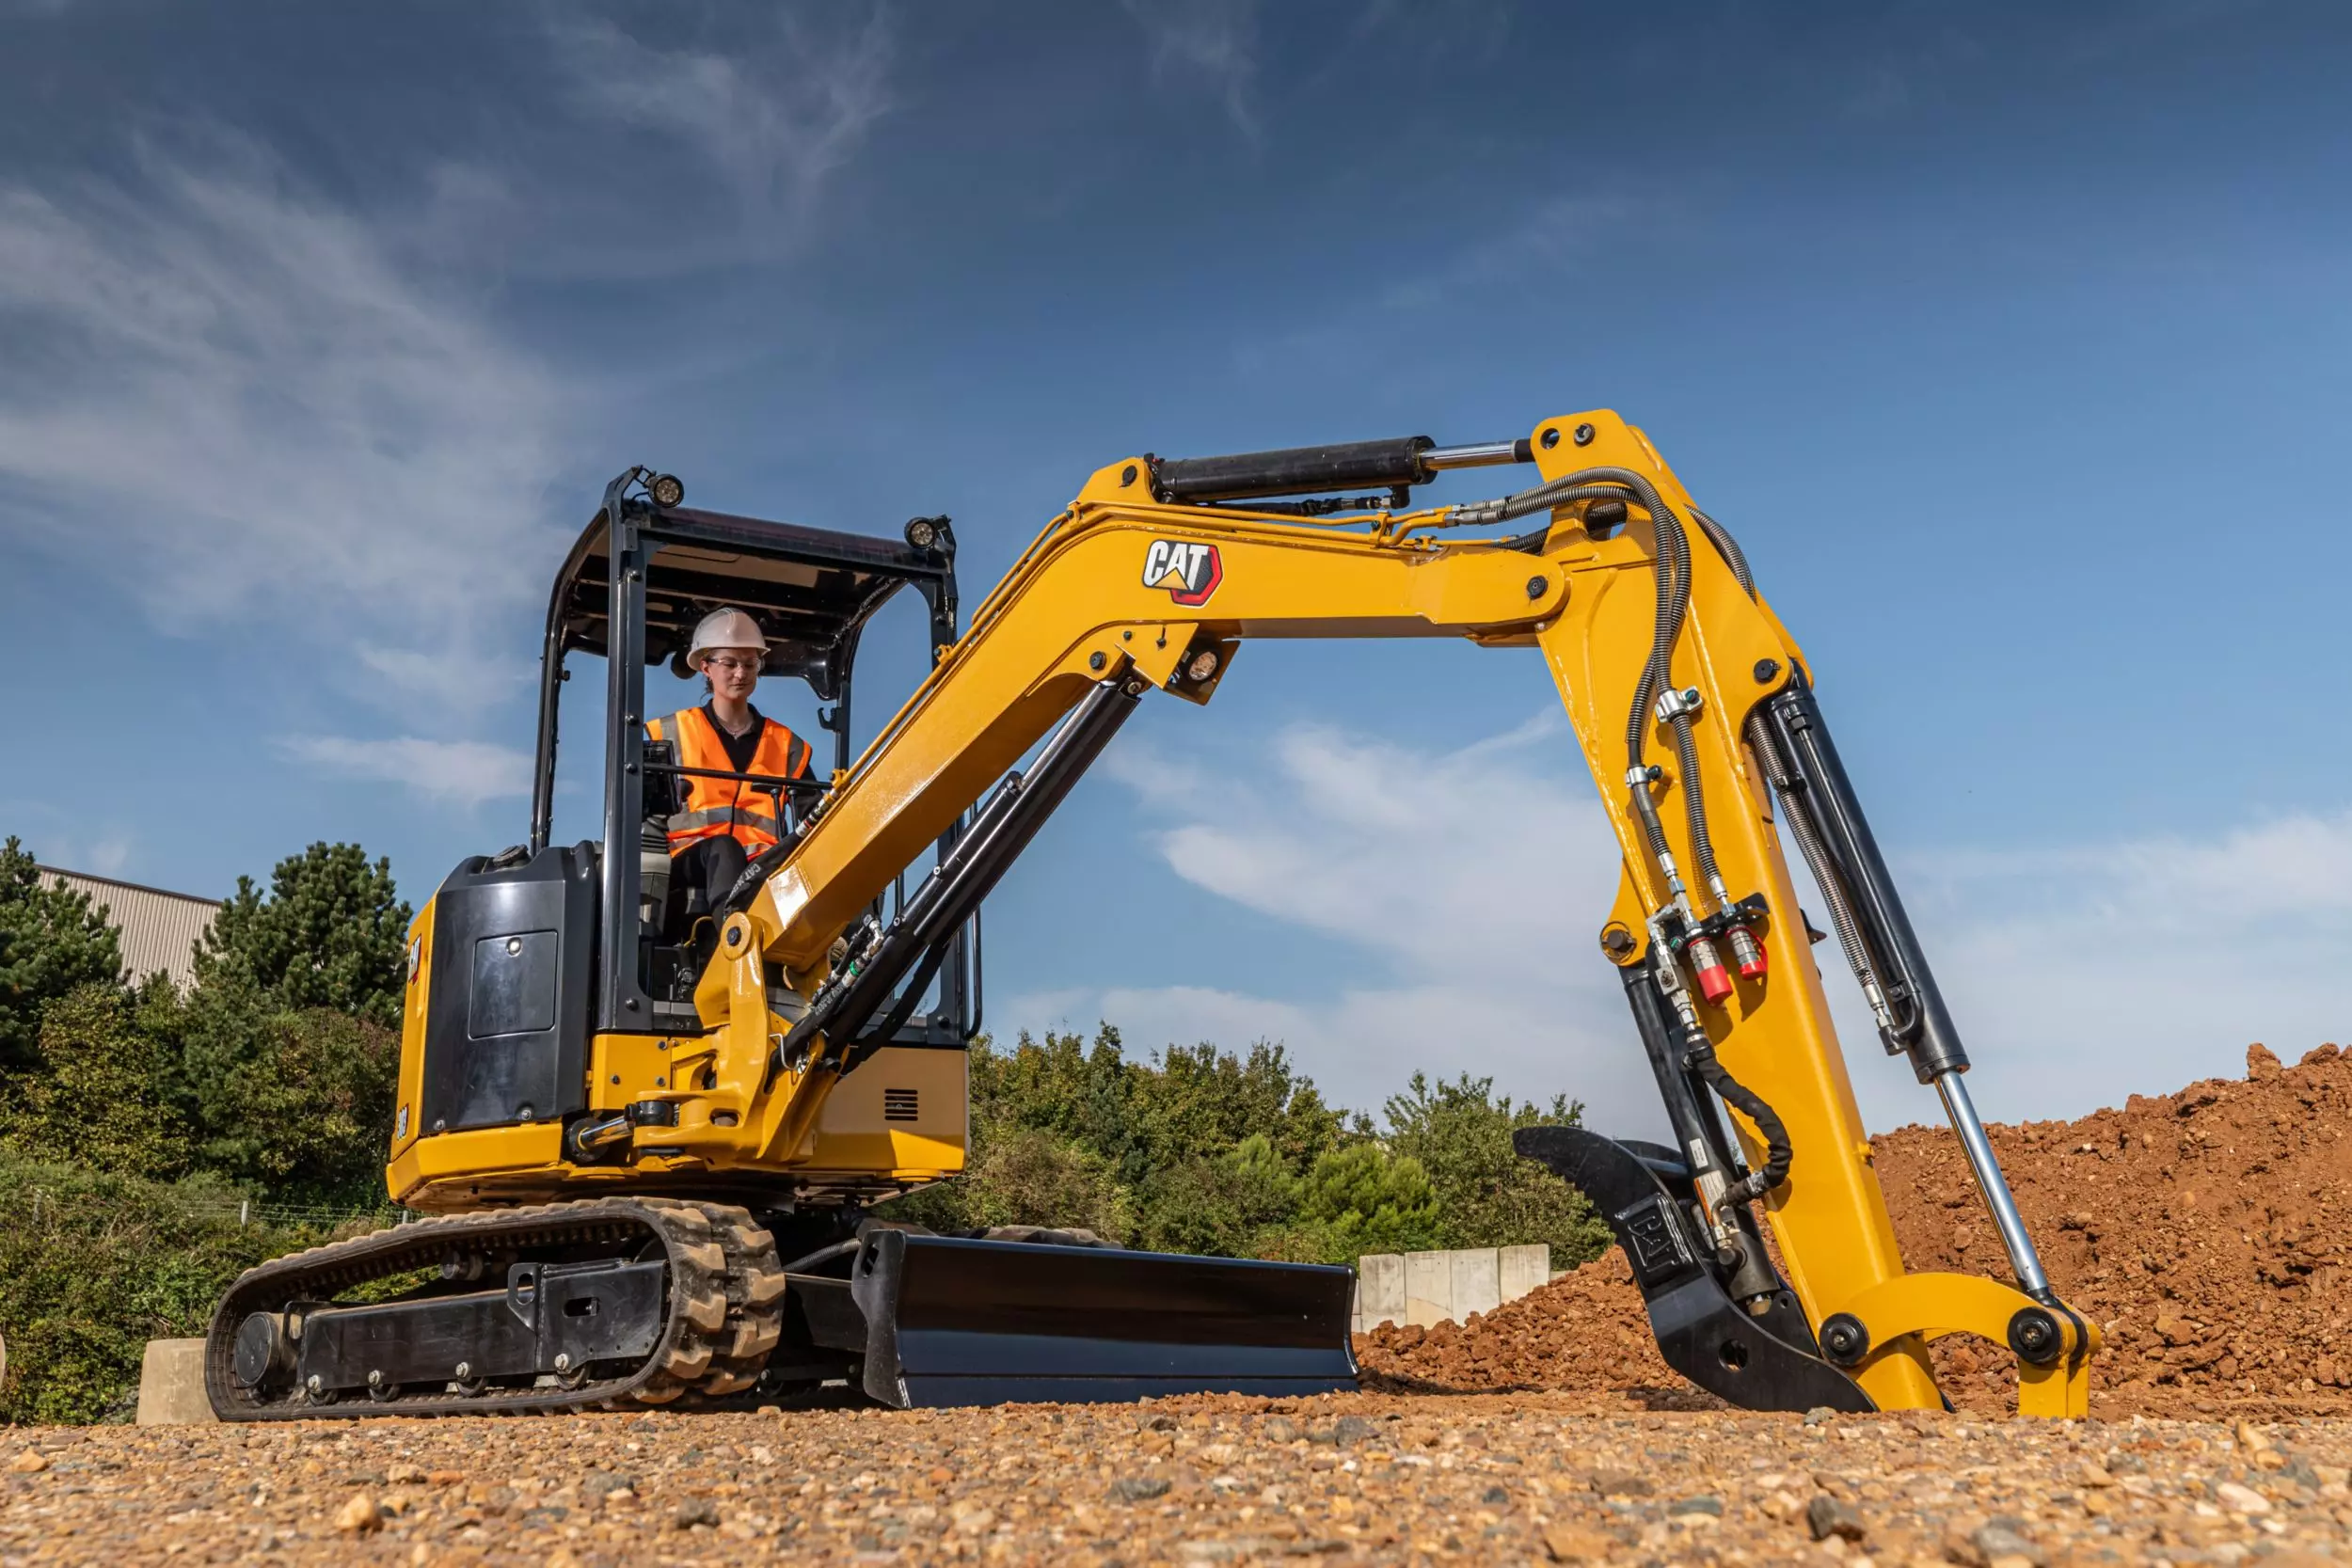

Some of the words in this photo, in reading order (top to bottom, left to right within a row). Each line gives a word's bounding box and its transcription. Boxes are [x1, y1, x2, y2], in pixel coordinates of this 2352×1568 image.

[1143, 540, 1210, 591] CAT
[744, 863, 761, 881] CAT
[1627, 1214, 1679, 1274] CAT
